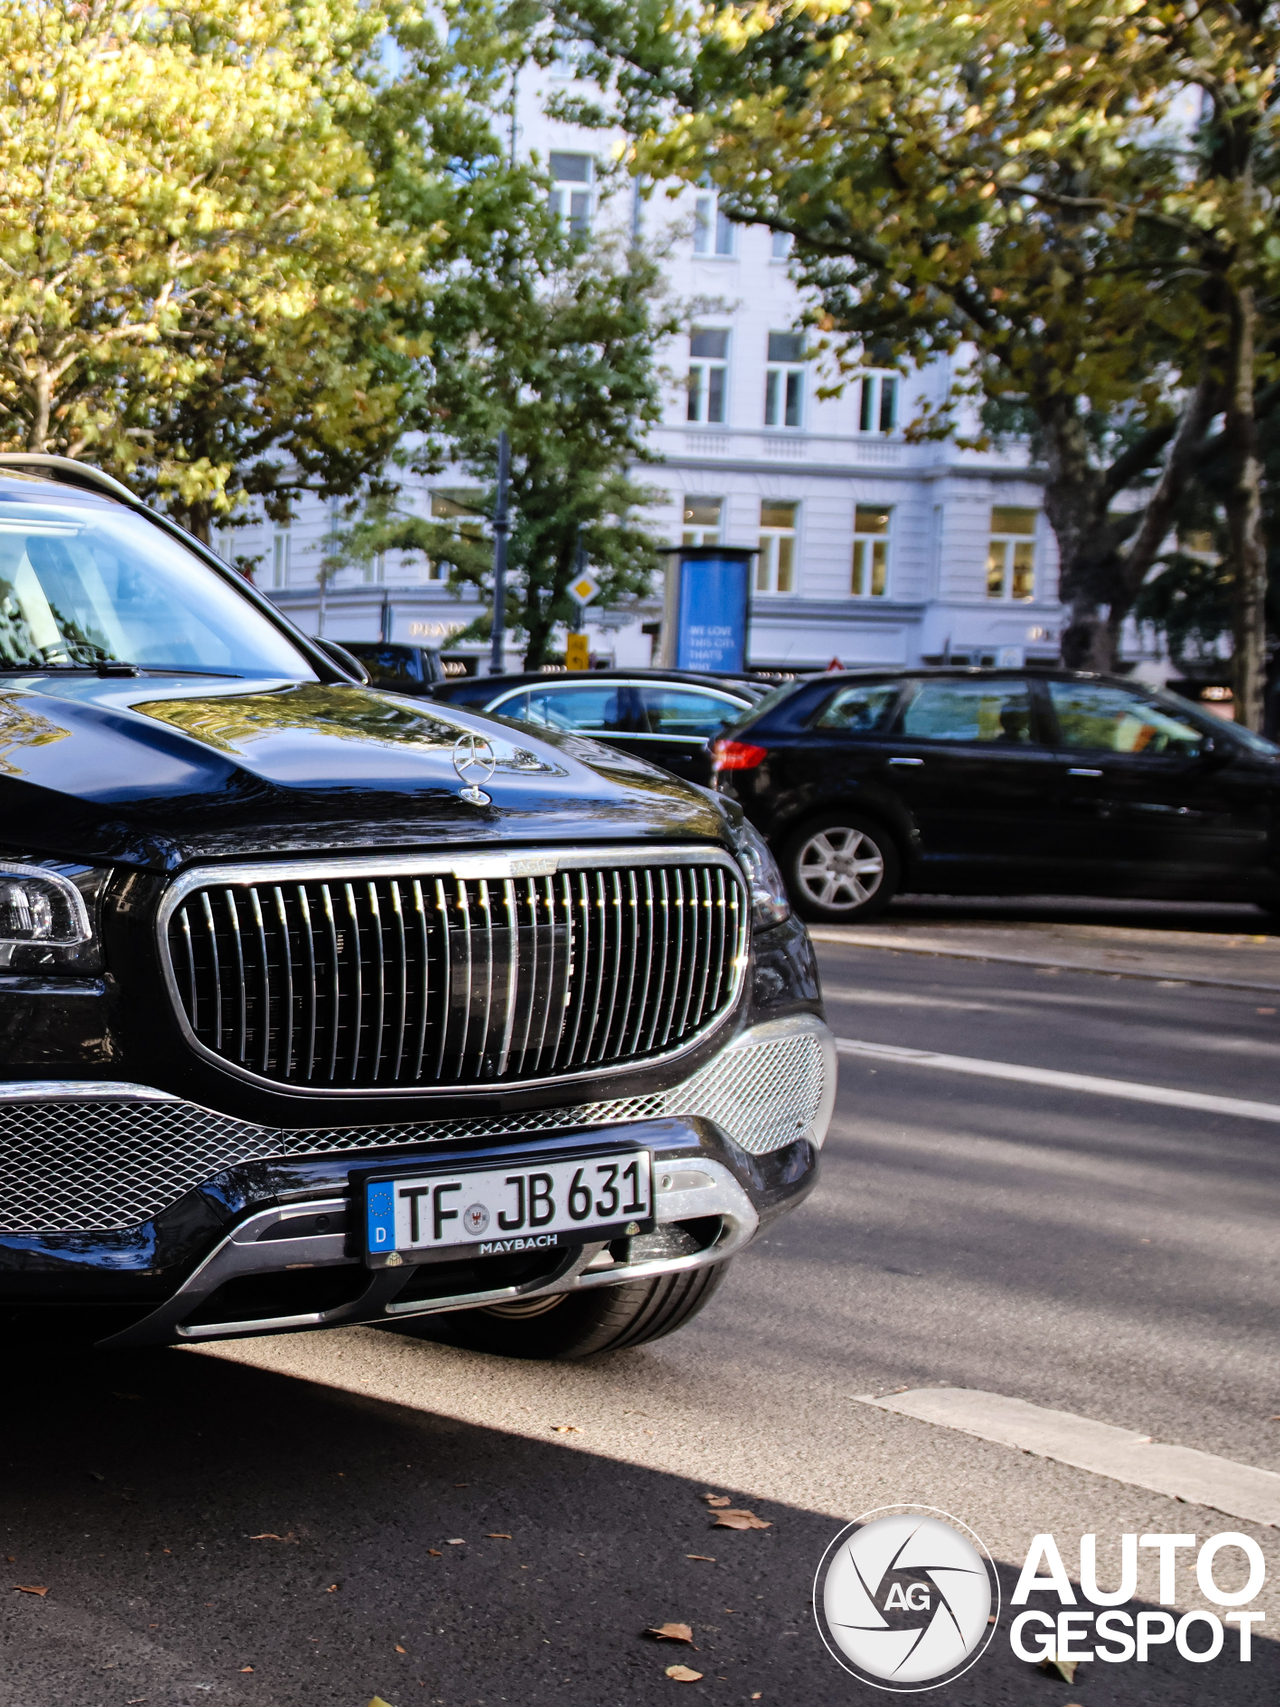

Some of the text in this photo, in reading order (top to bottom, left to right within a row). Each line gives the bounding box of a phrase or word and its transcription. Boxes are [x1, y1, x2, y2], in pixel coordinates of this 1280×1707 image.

[690, 625, 732, 636] WE LOVE
[690, 637, 712, 648] THIS
[399, 1182, 462, 1242] TF
[498, 1172, 556, 1231] JB
[568, 1160, 647, 1221] 631
[376, 1227, 387, 1243] D
[480, 1234, 559, 1255] MAYBACH
